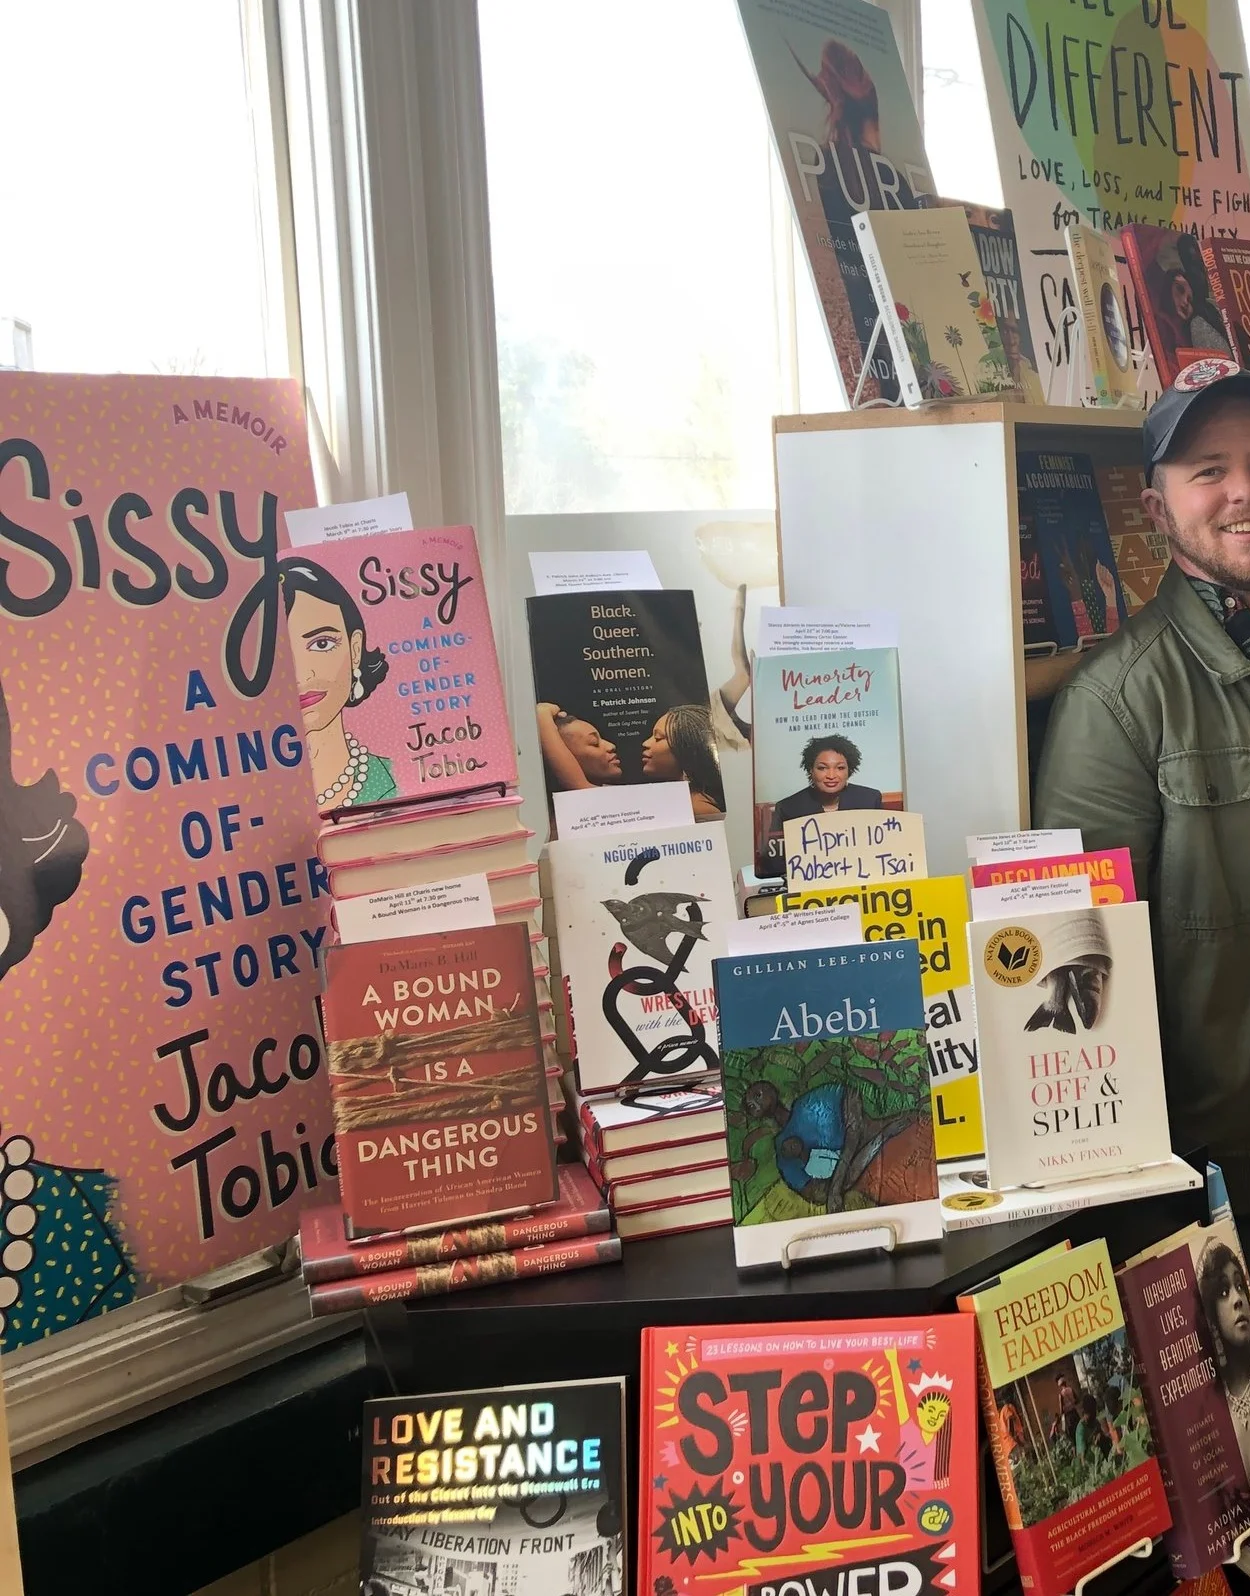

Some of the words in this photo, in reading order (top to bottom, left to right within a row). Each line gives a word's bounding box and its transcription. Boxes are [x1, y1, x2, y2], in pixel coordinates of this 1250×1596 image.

[1007, 12, 1243, 173] DIFFERENT
[1018, 154, 1074, 190] LOVE,
[1081, 169, 1128, 202] LOSS,
[1135, 180, 1162, 201] and
[1169, 186, 1201, 207] THE
[1053, 202, 1079, 230] for
[172, 404, 188, 426] A
[193, 400, 288, 456] MEMOIR
[0, 437, 284, 699] Sissy
[358, 555, 473, 626] Sissy
[422, 615, 433, 631] A
[591, 604, 636, 618] Black.
[388, 633, 472, 655] COMING-
[593, 626, 640, 640] Queer.
[418, 654, 449, 674] OF-
[583, 645, 654, 661] Southern.
[185, 669, 218, 712] A
[397, 672, 476, 698] GENDER
[591, 667, 650, 680] Women.
[782, 662, 875, 692] Minority
[410, 694, 472, 717] STORY
[794, 686, 861, 710] Leader
[405, 716, 483, 753] Jacob
[85, 724, 301, 796] COMING
[411, 749, 488, 785] Tobia
[181, 804, 265, 860] OF-
[662, 839, 712, 856] THIONG'O
[801, 818, 856, 855] April
[867, 816, 902, 846] 10th
[788, 855, 852, 882] Robert
[858, 858, 870, 878] L
[876, 853, 914, 877] Tsai
[121, 856, 327, 945] GENDER
[369, 895, 393, 904] DaMaris
[917, 912, 947, 941] in
[161, 926, 327, 1008] STORY
[733, 960, 808, 976] GILLIAN
[817, 949, 906, 968] LEE-FONG
[993, 970, 1022, 983] WINNER
[362, 984, 382, 1006] A
[393, 968, 502, 1002] BOUND
[374, 995, 496, 1030] WOMAN
[770, 998, 881, 1041] Abebi
[424, 1061, 448, 1082] IS
[456, 1058, 474, 1077] A
[1028, 1044, 1117, 1079] HEAD
[1031, 1076, 1090, 1107] OFF
[1100, 1072, 1120, 1097] &
[936, 1095, 965, 1125] L.
[1033, 1100, 1123, 1137] SPLIT
[357, 1112, 538, 1163] DANGEROUS
[403, 1146, 498, 1182] THING
[1039, 1152, 1081, 1167] NIKKY
[1080, 1146, 1124, 1161] FINNEY
[994, 1262, 1107, 1338] FREEDOM
[1143, 1268, 1188, 1308] WAYWARD
[1002, 1295, 1114, 1373] FARMERS
[1160, 1305, 1188, 1335] LIVES,
[706, 1345, 718, 1356] 23
[720, 1342, 762, 1354] LESSONS
[766, 1342, 779, 1351] ON
[783, 1340, 804, 1350] HOW
[820, 1339, 842, 1349] LIVE
[846, 1337, 868, 1347] YOUR
[872, 1337, 894, 1346] BEST
[898, 1336, 918, 1345] LIFE
[1159, 1331, 1203, 1371] BEAUTIFUL
[1160, 1356, 1217, 1407] EXPERIMENTS
[373, 1408, 464, 1445] LOVE
[473, 1402, 554, 1442] AND
[372, 1439, 601, 1485] RESISTANCE
[670, 1503, 727, 1546] INTO
[1048, 1506, 1097, 1539] AGRICULTURAL
[1098, 1482, 1134, 1509] RESISTANCE
[1066, 1528, 1087, 1544] BLACK
[1088, 1510, 1118, 1532] FREEDOM
[1118, 1487, 1152, 1513] MOVEMENT
[1208, 1504, 1243, 1536] SAIDIYA
[420, 1532, 510, 1555] LIBERATION
[519, 1534, 575, 1554] FRONT
